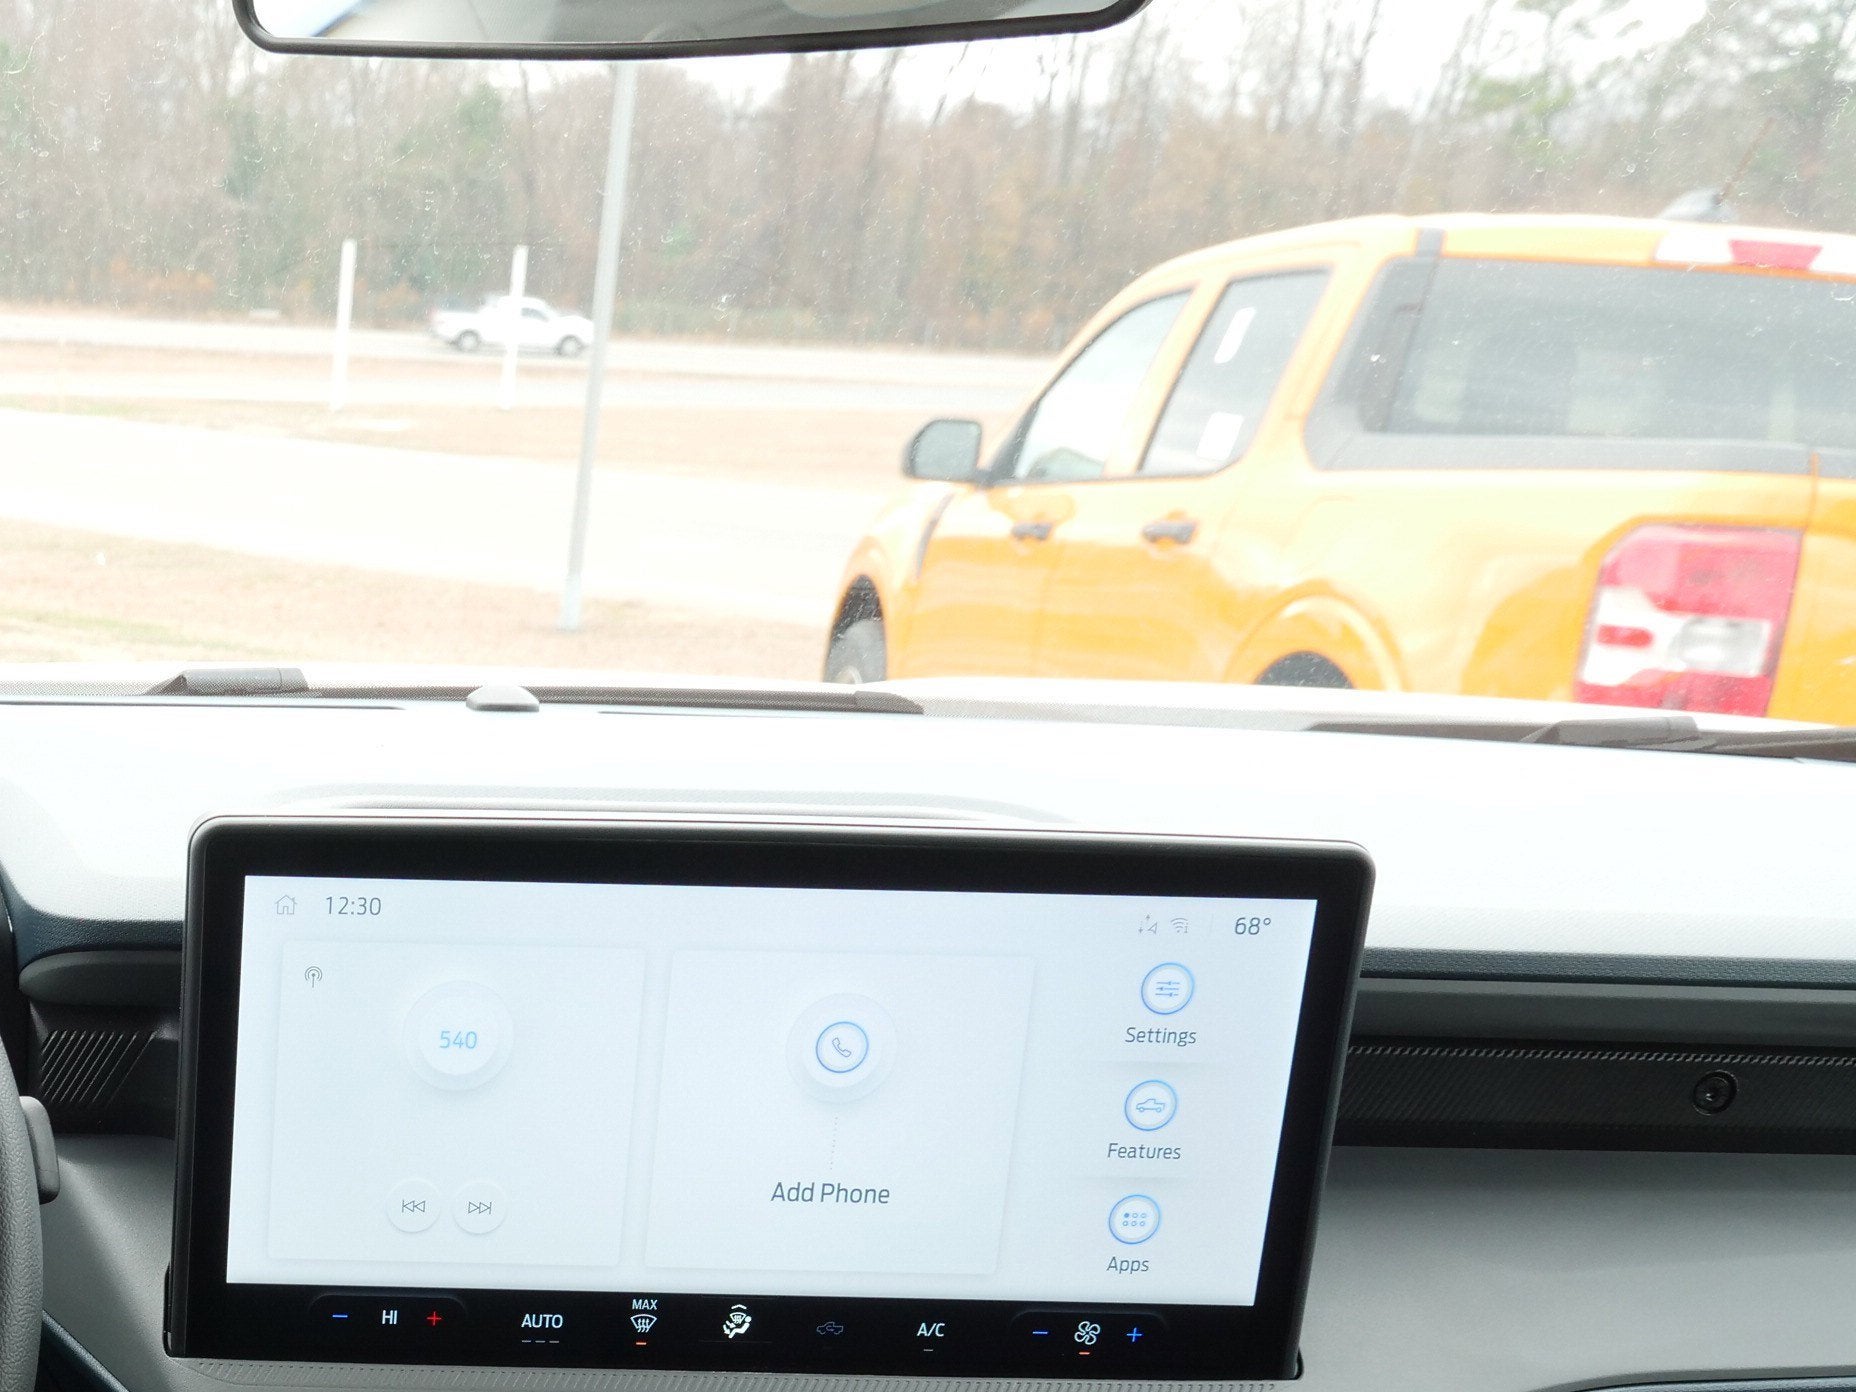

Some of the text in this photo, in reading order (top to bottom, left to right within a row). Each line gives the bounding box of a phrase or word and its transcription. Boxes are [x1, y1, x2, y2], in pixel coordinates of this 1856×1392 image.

[326, 896, 382, 916] 12:30
[1234, 917, 1272, 936] 68°
[439, 1030, 478, 1050] 540
[1125, 1027, 1197, 1047] Settings
[1107, 1142, 1182, 1160] Features
[770, 1181, 891, 1205] Add Phone
[1106, 1255, 1150, 1275] Apps
[632, 1298, 658, 1311] MAX
[381, 1310, 398, 1326] HI
[521, 1313, 564, 1330] AUTO
[916, 1321, 946, 1338] A/C
